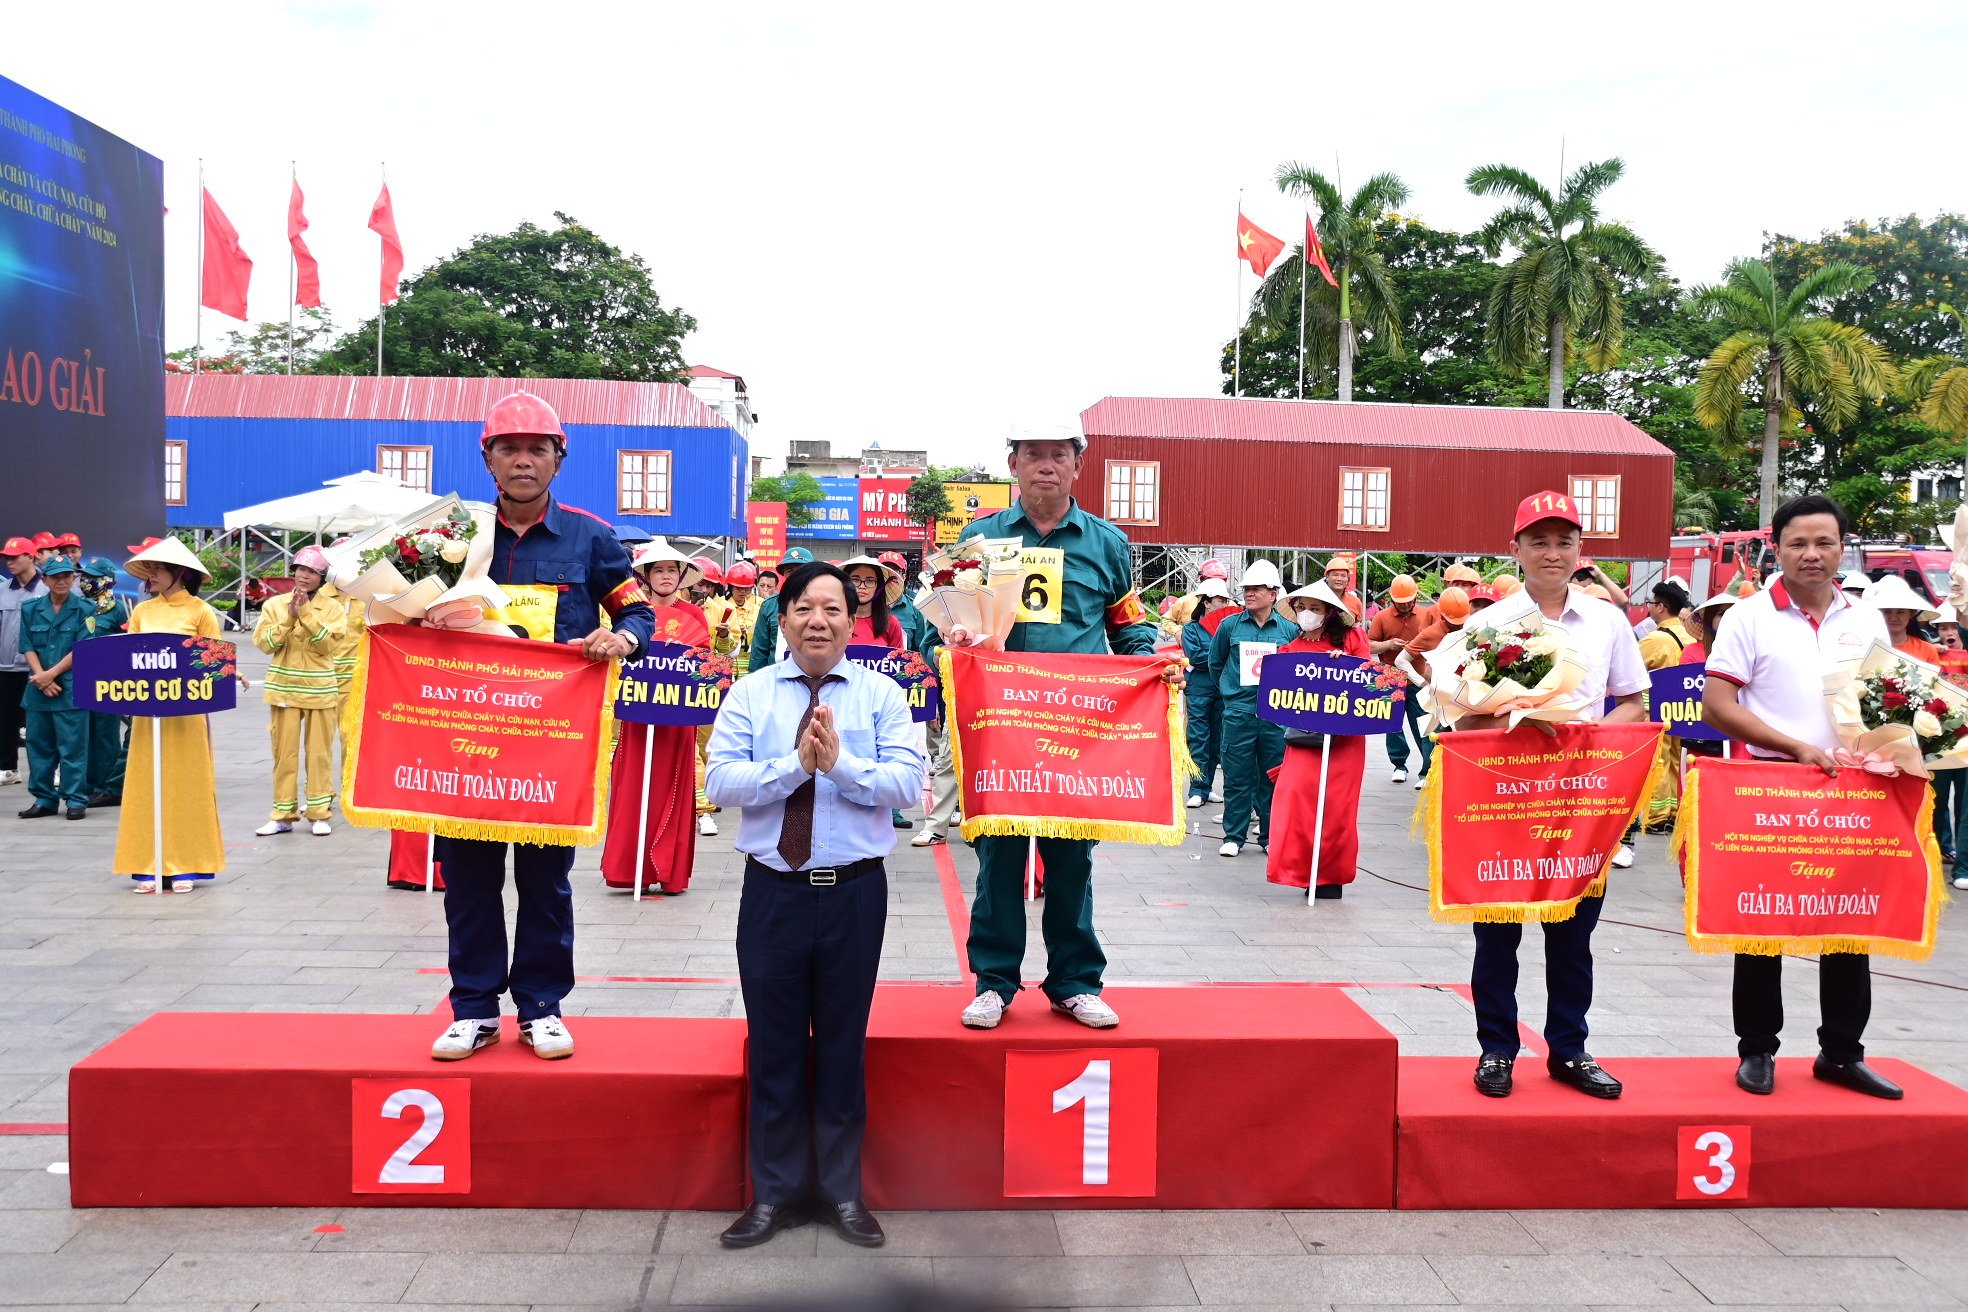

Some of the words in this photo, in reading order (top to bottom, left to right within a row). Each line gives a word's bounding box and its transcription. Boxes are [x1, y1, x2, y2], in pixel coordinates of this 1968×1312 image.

[50, 348, 106, 416] GIẢI
[863, 489, 884, 512] MỸ
[1531, 494, 1568, 512] 114
[829, 508, 850, 521] GIA
[866, 516, 901, 527] KHÁNH
[1040, 557, 1056, 565] AN
[515, 595, 540, 606] LÃNG
[1021, 573, 1049, 611] 6
[1476, 585, 1493, 595] 114
[132, 646, 177, 670] KHỐI
[405, 654, 434, 667] UBND
[438, 657, 473, 671] THÀNH
[476, 662, 500, 674] PHỐ
[502, 664, 521, 677] HẢI
[524, 667, 564, 680] PHÒNG
[646, 654, 696, 673] TUYỂN
[986, 663, 1014, 673] UBND
[1017, 665, 1051, 678] THÀNH
[1054, 673, 1075, 682] PHỐ
[1099, 676, 1138, 687] PHÒNG
[1295, 663, 1321, 681] ĐỘI
[1325, 662, 1371, 684] TUYỂN
[1683, 674, 1705, 692] ĐỘ
[95, 679, 150, 702] PCCC
[155, 677, 182, 701] CƠ
[187, 672, 213, 701] SỞ
[421, 684, 458, 701] BAN
[462, 684, 488, 704] TỔ
[491, 691, 543, 709] CHỨC
[652, 682, 680, 706] AN
[685, 682, 720, 709] LÃO
[1002, 688, 1039, 702] BAN
[1043, 686, 1067, 705] TỔ
[1071, 694, 1118, 713] CHỨC
[1268, 687, 1319, 714] QUẬN
[1324, 690, 1349, 715] ĐỒ
[1354, 697, 1392, 720] SƠN
[393, 702, 405, 711] HỘI
[406, 704, 415, 712] THI
[415, 706, 439, 717] NGHIỆP
[441, 709, 451, 719] VỤ
[452, 709, 472, 720] CHỮA
[474, 712, 494, 722] CHÁY
[496, 713, 506, 723] VÀ
[507, 715, 522, 725] CỨU
[544, 717, 558, 727] CỨU
[560, 719, 571, 729] HỘ
[549, 729, 566, 739] NĂM
[567, 732, 584, 740] 2024
[451, 737, 500, 759] Tặng
[1035, 737, 1080, 760] Tặng
[1478, 756, 1506, 767] UBND
[1507, 753, 1541, 765] THÀNH
[1543, 750, 1565, 763] PHỐ
[1566, 748, 1583, 760] HẢI
[1586, 747, 1624, 760] PHÒNG
[395, 758, 429, 792] GIẢI
[431, 766, 460, 796] NHÌ
[463, 769, 508, 800] TOÀN
[509, 772, 557, 803] ĐOÀN
[975, 759, 1004, 793] GIẢI
[1008, 760, 1053, 793] NHẤT
[1056, 769, 1098, 797] TOÀN
[1101, 769, 1145, 799] ĐOÀN
[1495, 781, 1531, 795] BAN
[1534, 773, 1556, 793] TỔ
[1560, 772, 1607, 790] CHỨC
[1735, 787, 1763, 797] UBND
[1765, 786, 1800, 799] THÀNH
[1802, 788, 1825, 799] PHỐ
[1826, 787, 1844, 799] HẢI
[1847, 788, 1886, 800] PHÒNG
[1754, 812, 1791, 827] BAN
[1795, 808, 1819, 828] TỔ
[1823, 812, 1871, 829] CHỨC
[1529, 824, 1573, 843] Tặng
[1724, 832, 1738, 841] HỘI
[1739, 833, 1749, 841] THI
[1750, 833, 1776, 843] NGHIỆP
[1777, 835, 1786, 844] VỤ
[1787, 834, 1808, 843] CHỮA
[1808, 835, 1828, 844] CHÁY
[1830, 835, 1839, 844] VÀ
[1840, 836, 1855, 845] CỨU
[1873, 836, 1887, 845] CỨU
[1888, 837, 1900, 847] HỘ
[1725, 843, 1740, 852] LIÊN
[1741, 845, 1754, 853] GIA
[1767, 845, 1787, 854] TOÀN
[1787, 845, 1813, 855] PHÒNG
[1836, 847, 1855, 856] CHỮA
[1879, 848, 1895, 857] NĂM
[1896, 850, 1913, 858] 2024
[1477, 850, 1509, 882] GIẢI
[1513, 858, 1534, 880] BA
[1537, 850, 1576, 880] TOÀN
[1576, 847, 1603, 878] ĐOÀN
[1790, 861, 1836, 879] Tặng
[1737, 883, 1771, 915] GIẢI
[1774, 893, 1794, 916] BA
[1798, 887, 1836, 916] TOÀN
[1837, 887, 1880, 916] ĐOÀN
[1052, 1059, 1112, 1186] 1
[379, 1088, 446, 1184] 2
[1692, 1130, 1736, 1195] 3
